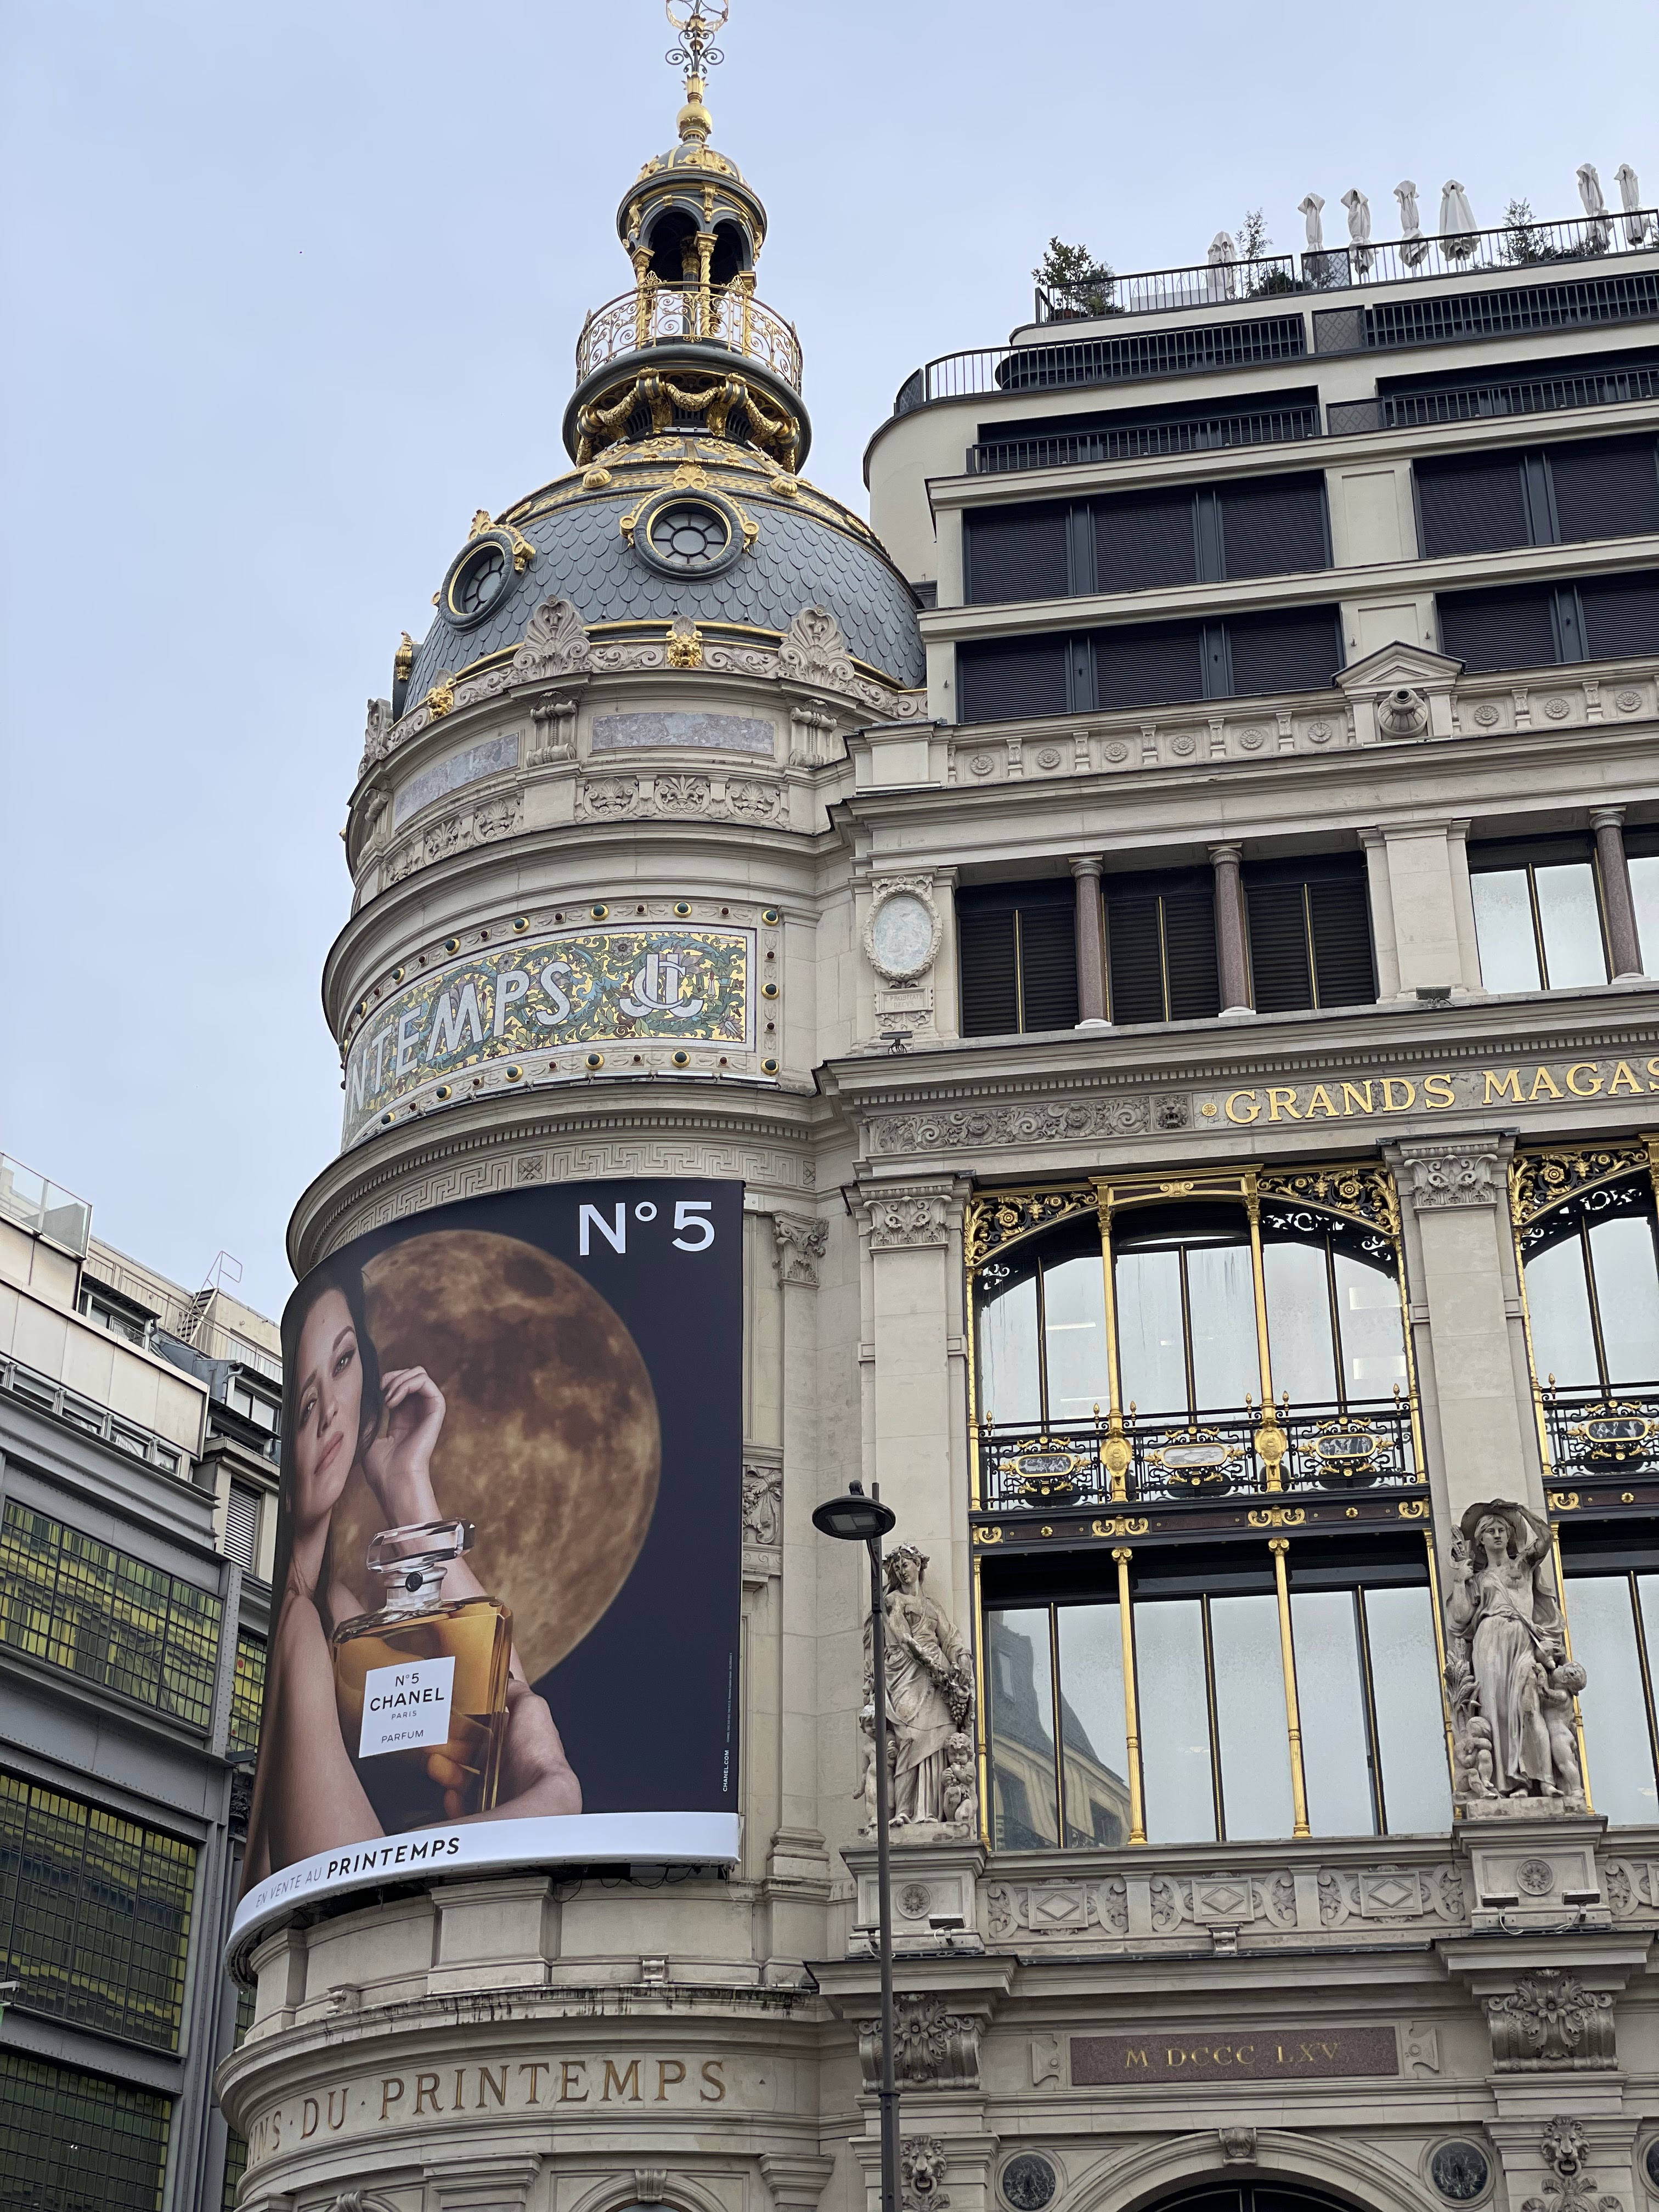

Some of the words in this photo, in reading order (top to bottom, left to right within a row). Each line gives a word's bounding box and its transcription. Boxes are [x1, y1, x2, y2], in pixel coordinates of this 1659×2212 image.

[1225, 1074, 1455, 1124] GRANDS
[370, 1688, 444, 1711] CHANEL
[391, 1710, 417, 1720] PARIS
[381, 1729, 424, 1743] PARFUM
[256, 1892, 268, 1908] EN
[270, 1874, 302, 1900] VENTE
[305, 1866, 322, 1884] AU
[326, 1837, 460, 1880] PRINTEMPS
[1125, 2048, 1149, 2068] M
[1166, 2045, 1256, 2067] DCCC
[1276, 2042, 1339, 2064] LXV
[300, 2087, 349, 2140] DU
[377, 2058, 727, 2121] PRINTEMPS
